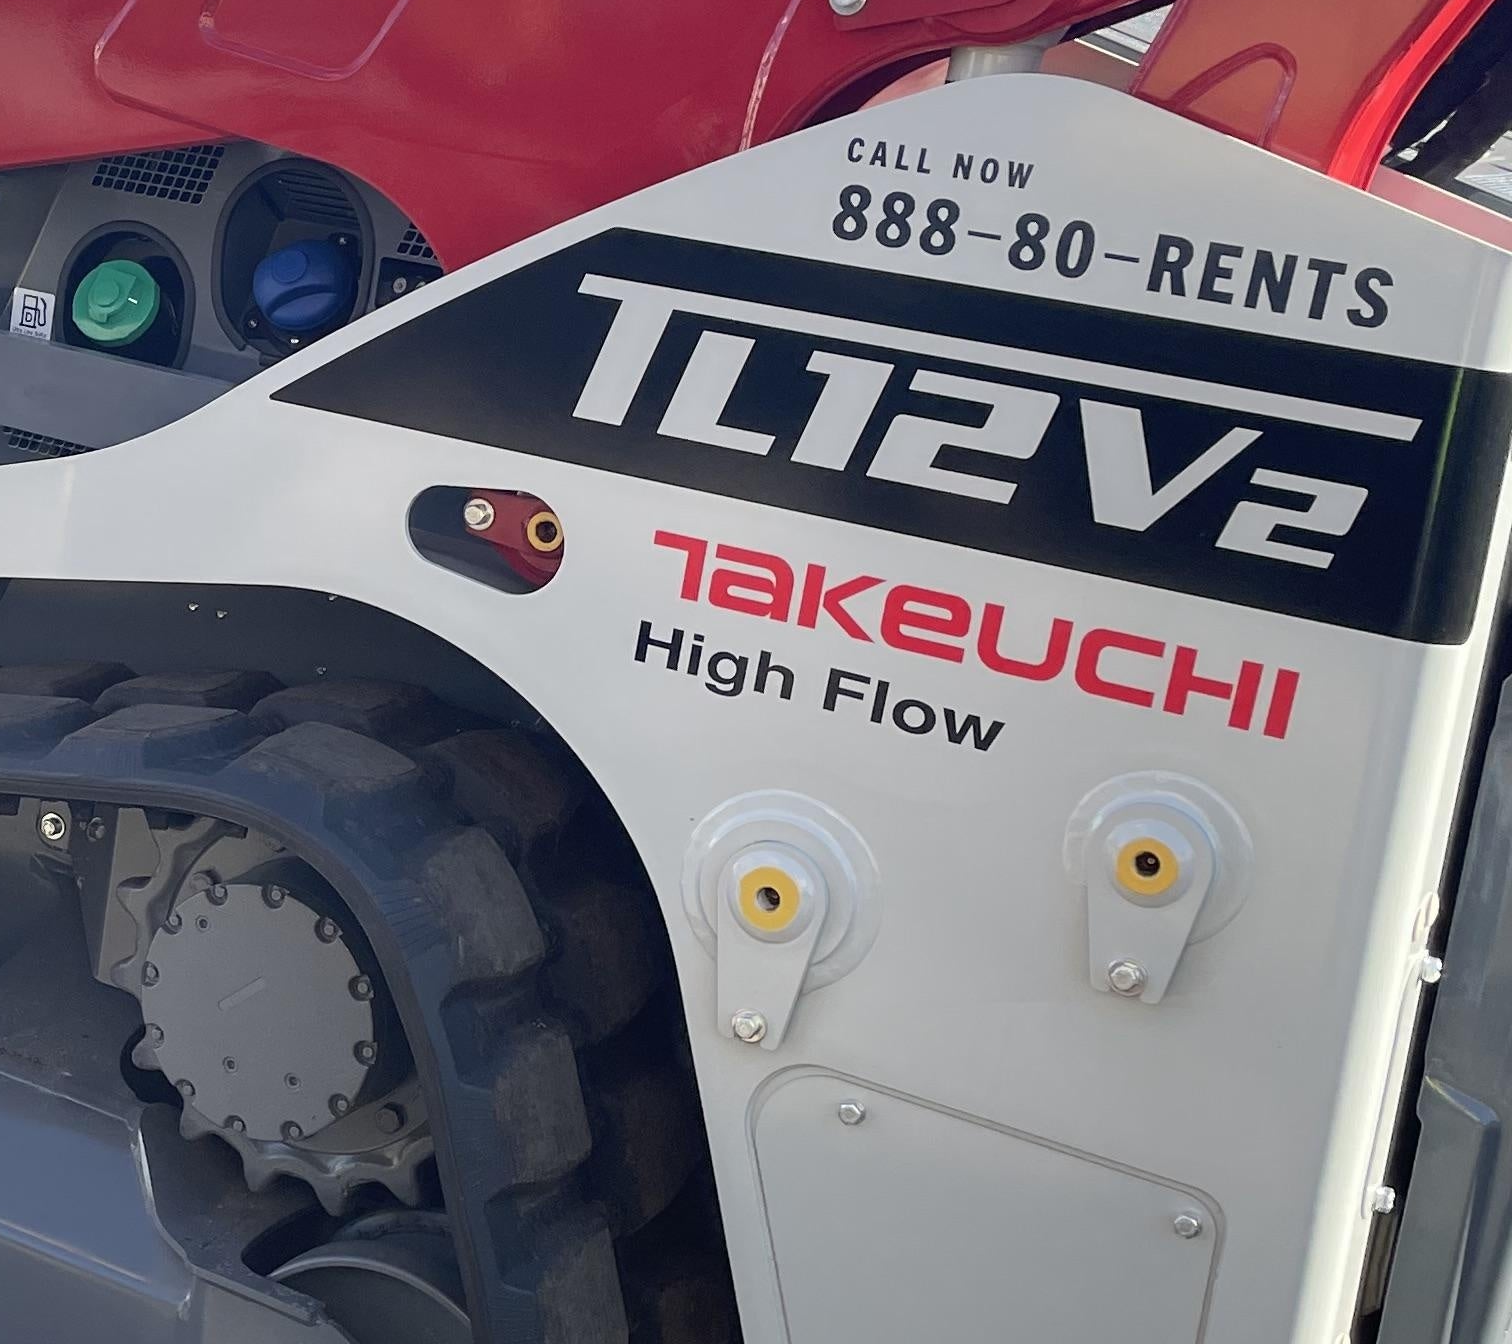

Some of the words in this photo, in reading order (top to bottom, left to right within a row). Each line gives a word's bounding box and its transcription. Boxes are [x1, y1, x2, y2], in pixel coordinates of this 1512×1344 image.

[847, 137, 932, 175] CALL
[952, 153, 1035, 189] NOW
[832, 184, 1395, 330] 888-80-RENTS
[573, 273, 1424, 570] TL12V2
[634, 619, 796, 702] High
[822, 667, 1007, 753] Flow
